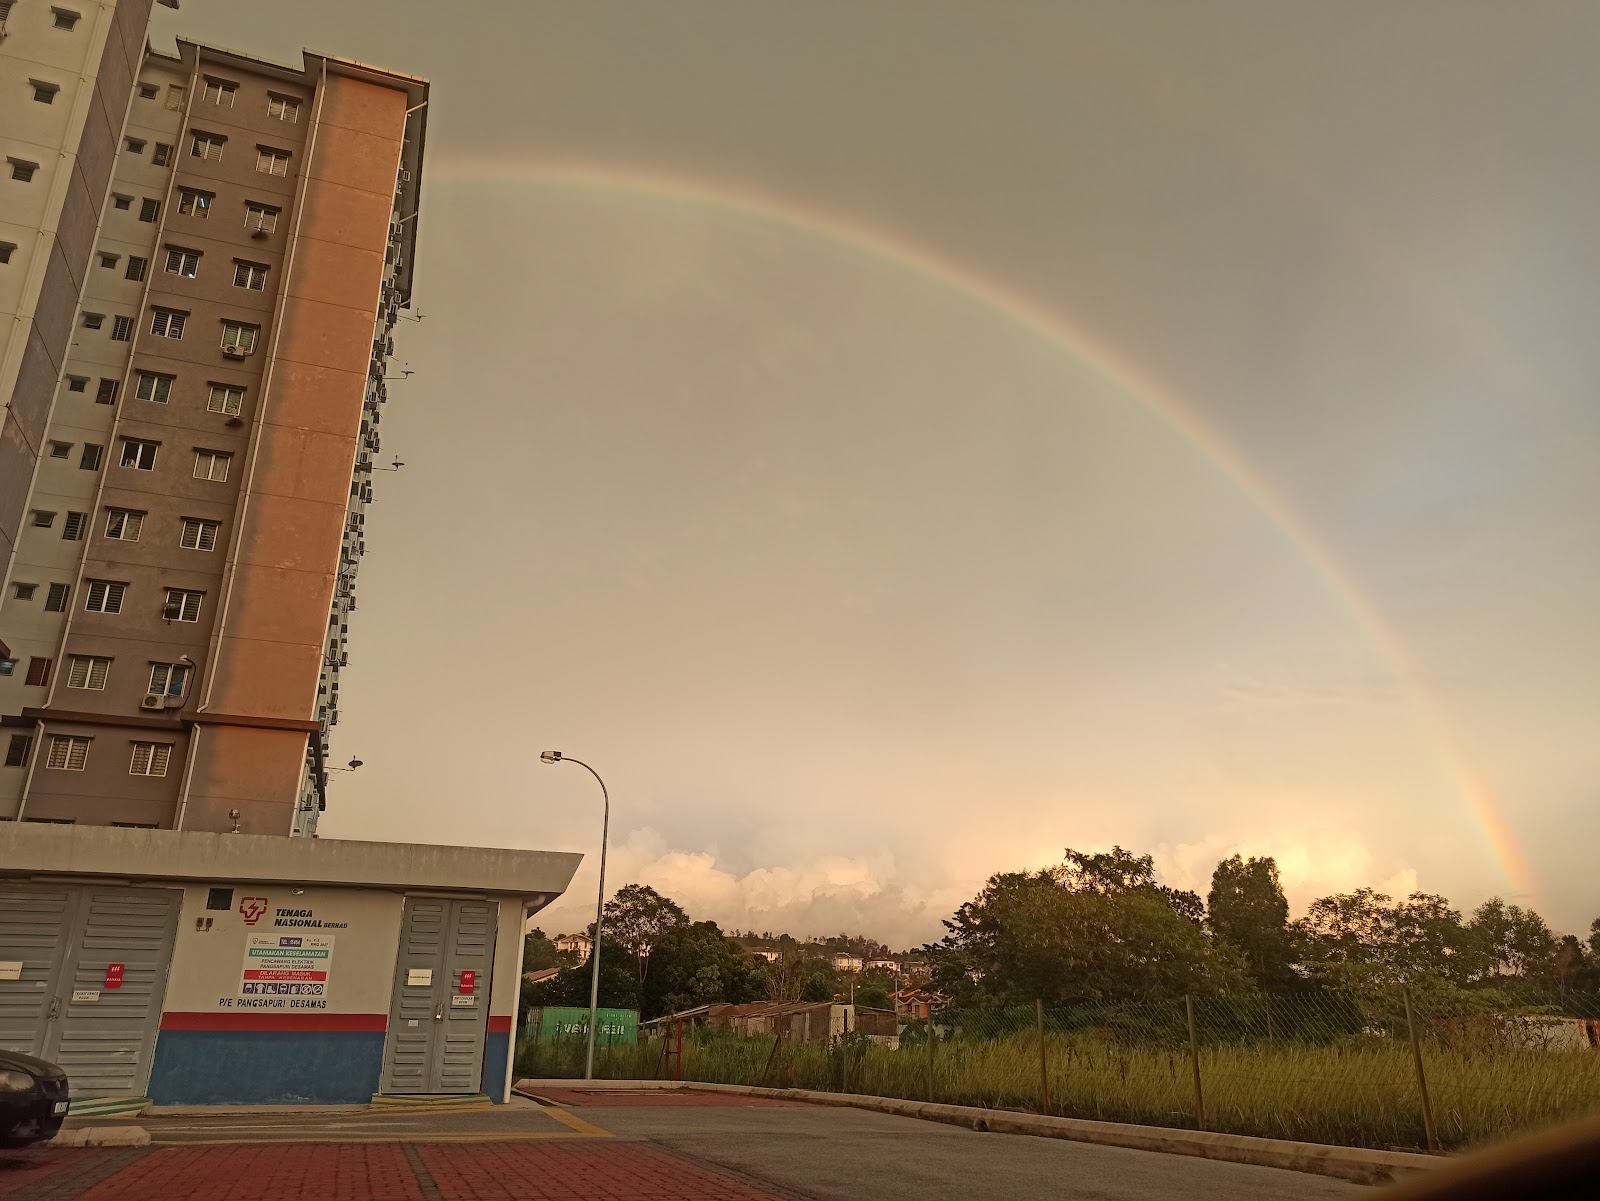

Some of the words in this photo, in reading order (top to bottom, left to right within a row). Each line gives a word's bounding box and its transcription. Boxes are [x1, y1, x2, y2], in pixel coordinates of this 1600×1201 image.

[276, 909, 313, 918] TENAGA
[274, 918, 322, 928] NASIONAL
[219, 998, 233, 1007] P/E
[237, 998, 286, 1008] PANGSAPURI
[290, 999, 327, 1009] DESAMAS
